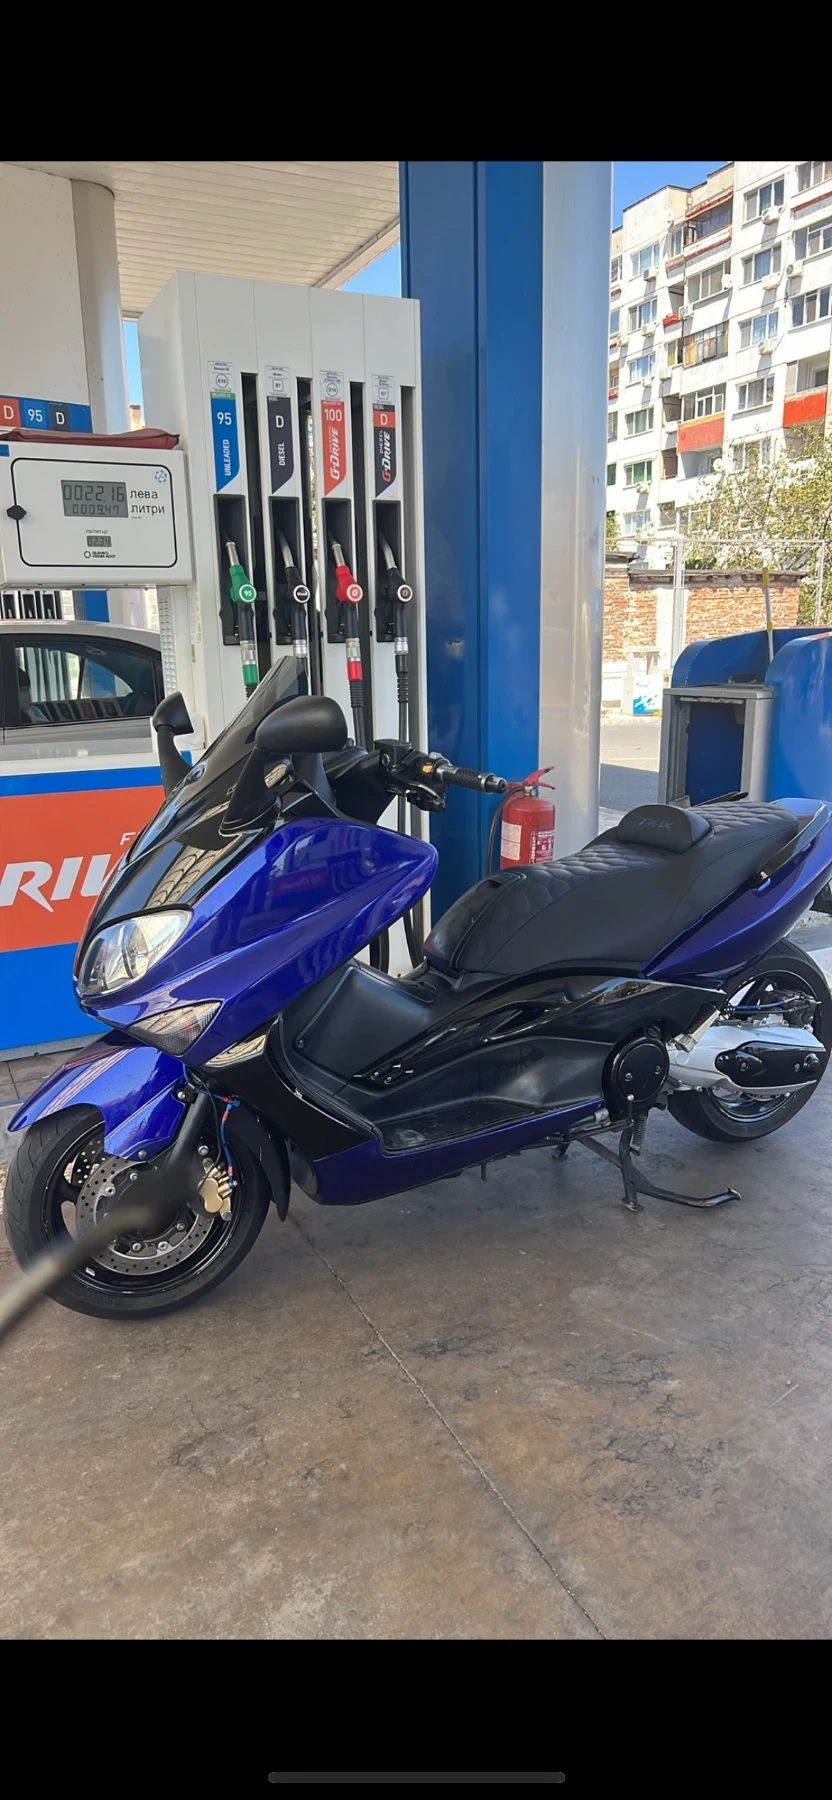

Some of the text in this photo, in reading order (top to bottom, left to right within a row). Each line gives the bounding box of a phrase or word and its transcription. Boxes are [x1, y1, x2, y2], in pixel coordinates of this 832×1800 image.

[3, 405, 65, 425] D 95 D
[217, 412, 232, 426] 95
[275, 415, 285, 428] D
[324, 408, 343, 422] 100
[380, 413, 388, 426] D
[224, 439, 232, 476] UNLEADED
[130, 490, 158, 499] лева
[131, 505, 165, 516] литри
